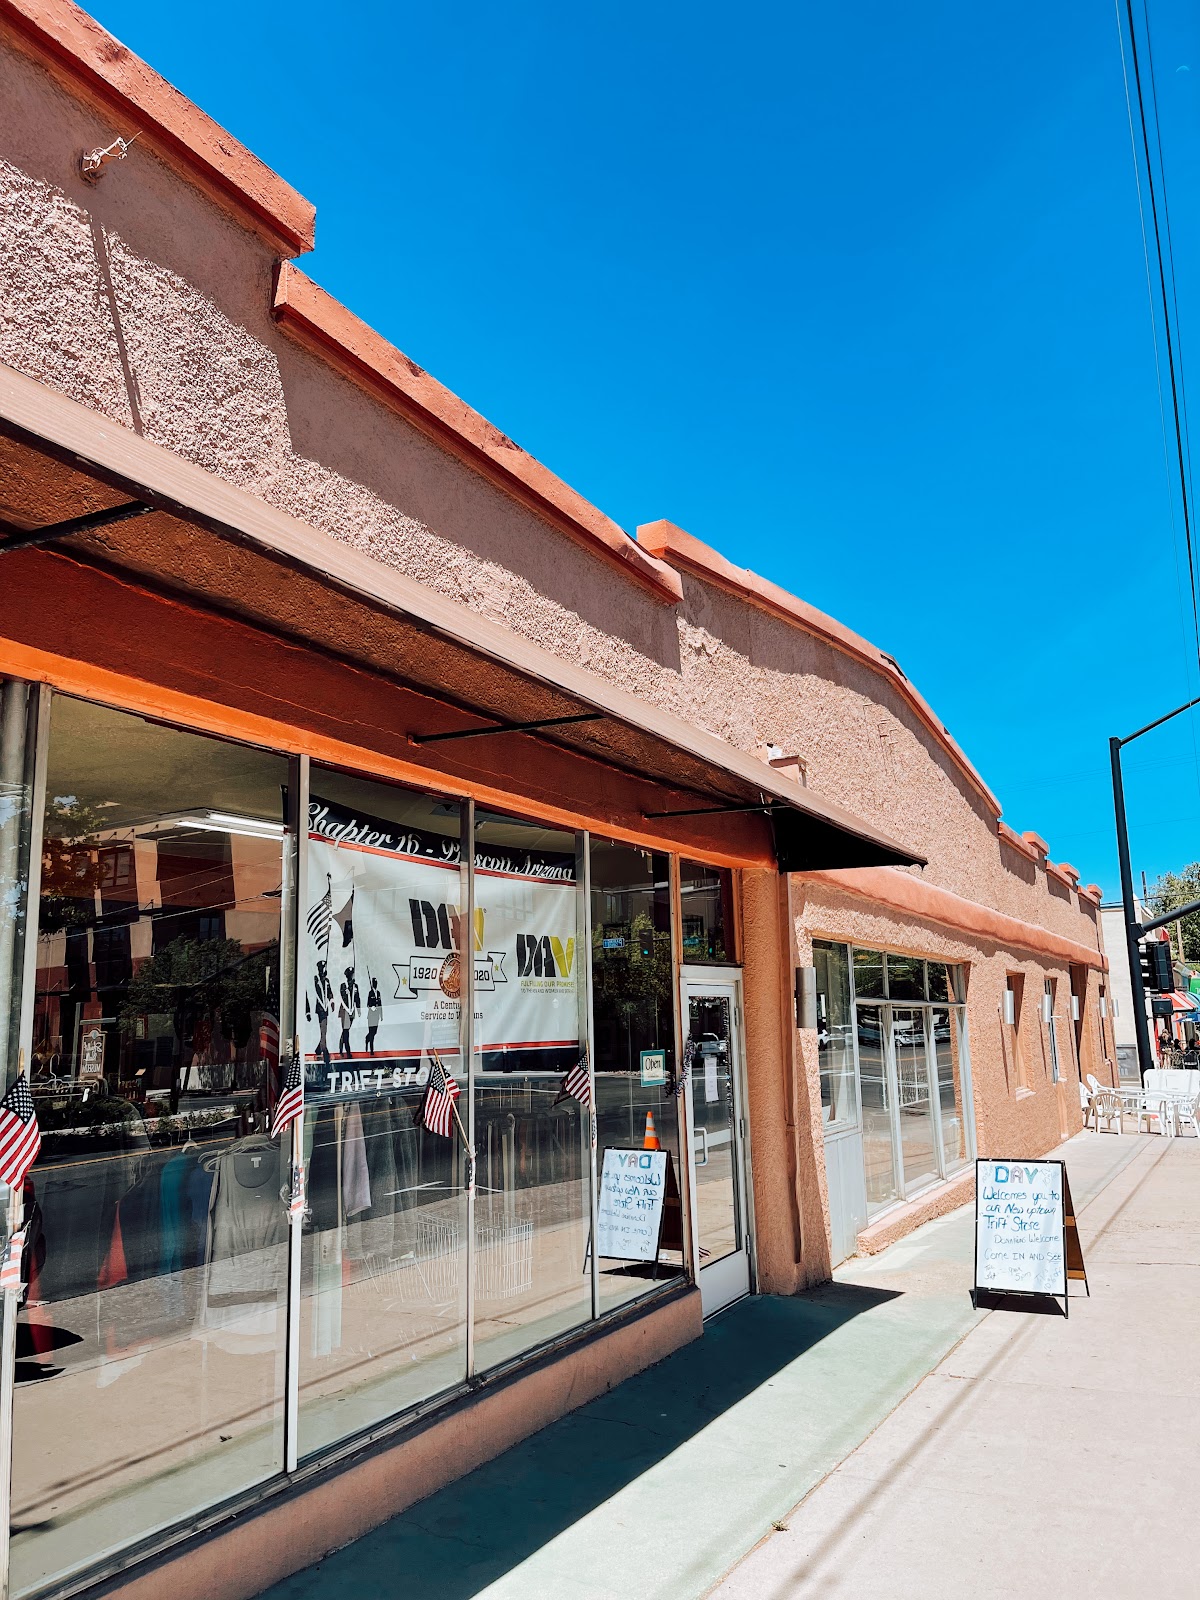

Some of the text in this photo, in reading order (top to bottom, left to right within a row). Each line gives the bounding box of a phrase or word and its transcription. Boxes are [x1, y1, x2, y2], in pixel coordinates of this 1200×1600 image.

[308, 802, 393, 851] Chapter
[394, 833, 422, 855] 16
[515, 855, 573, 880] Arizona
[516, 933, 575, 978] DAV
[413, 966, 438, 980] 1920
[543, 980, 556, 988] OUR
[433, 1000, 461, 1010] A Centu
[420, 1011, 447, 1021] Service
[448, 1011, 455, 1020] to
[645, 1057, 661, 1071] Open
[326, 1069, 385, 1094] TRIFT
[994, 1165, 1039, 1185] DAV
[982, 1186, 1061, 1206] Welcomes you to
[1011, 1215, 1041, 1232] Store
[1012, 1252, 1025, 1261] IN
[1029, 1253, 1045, 1261] AND
